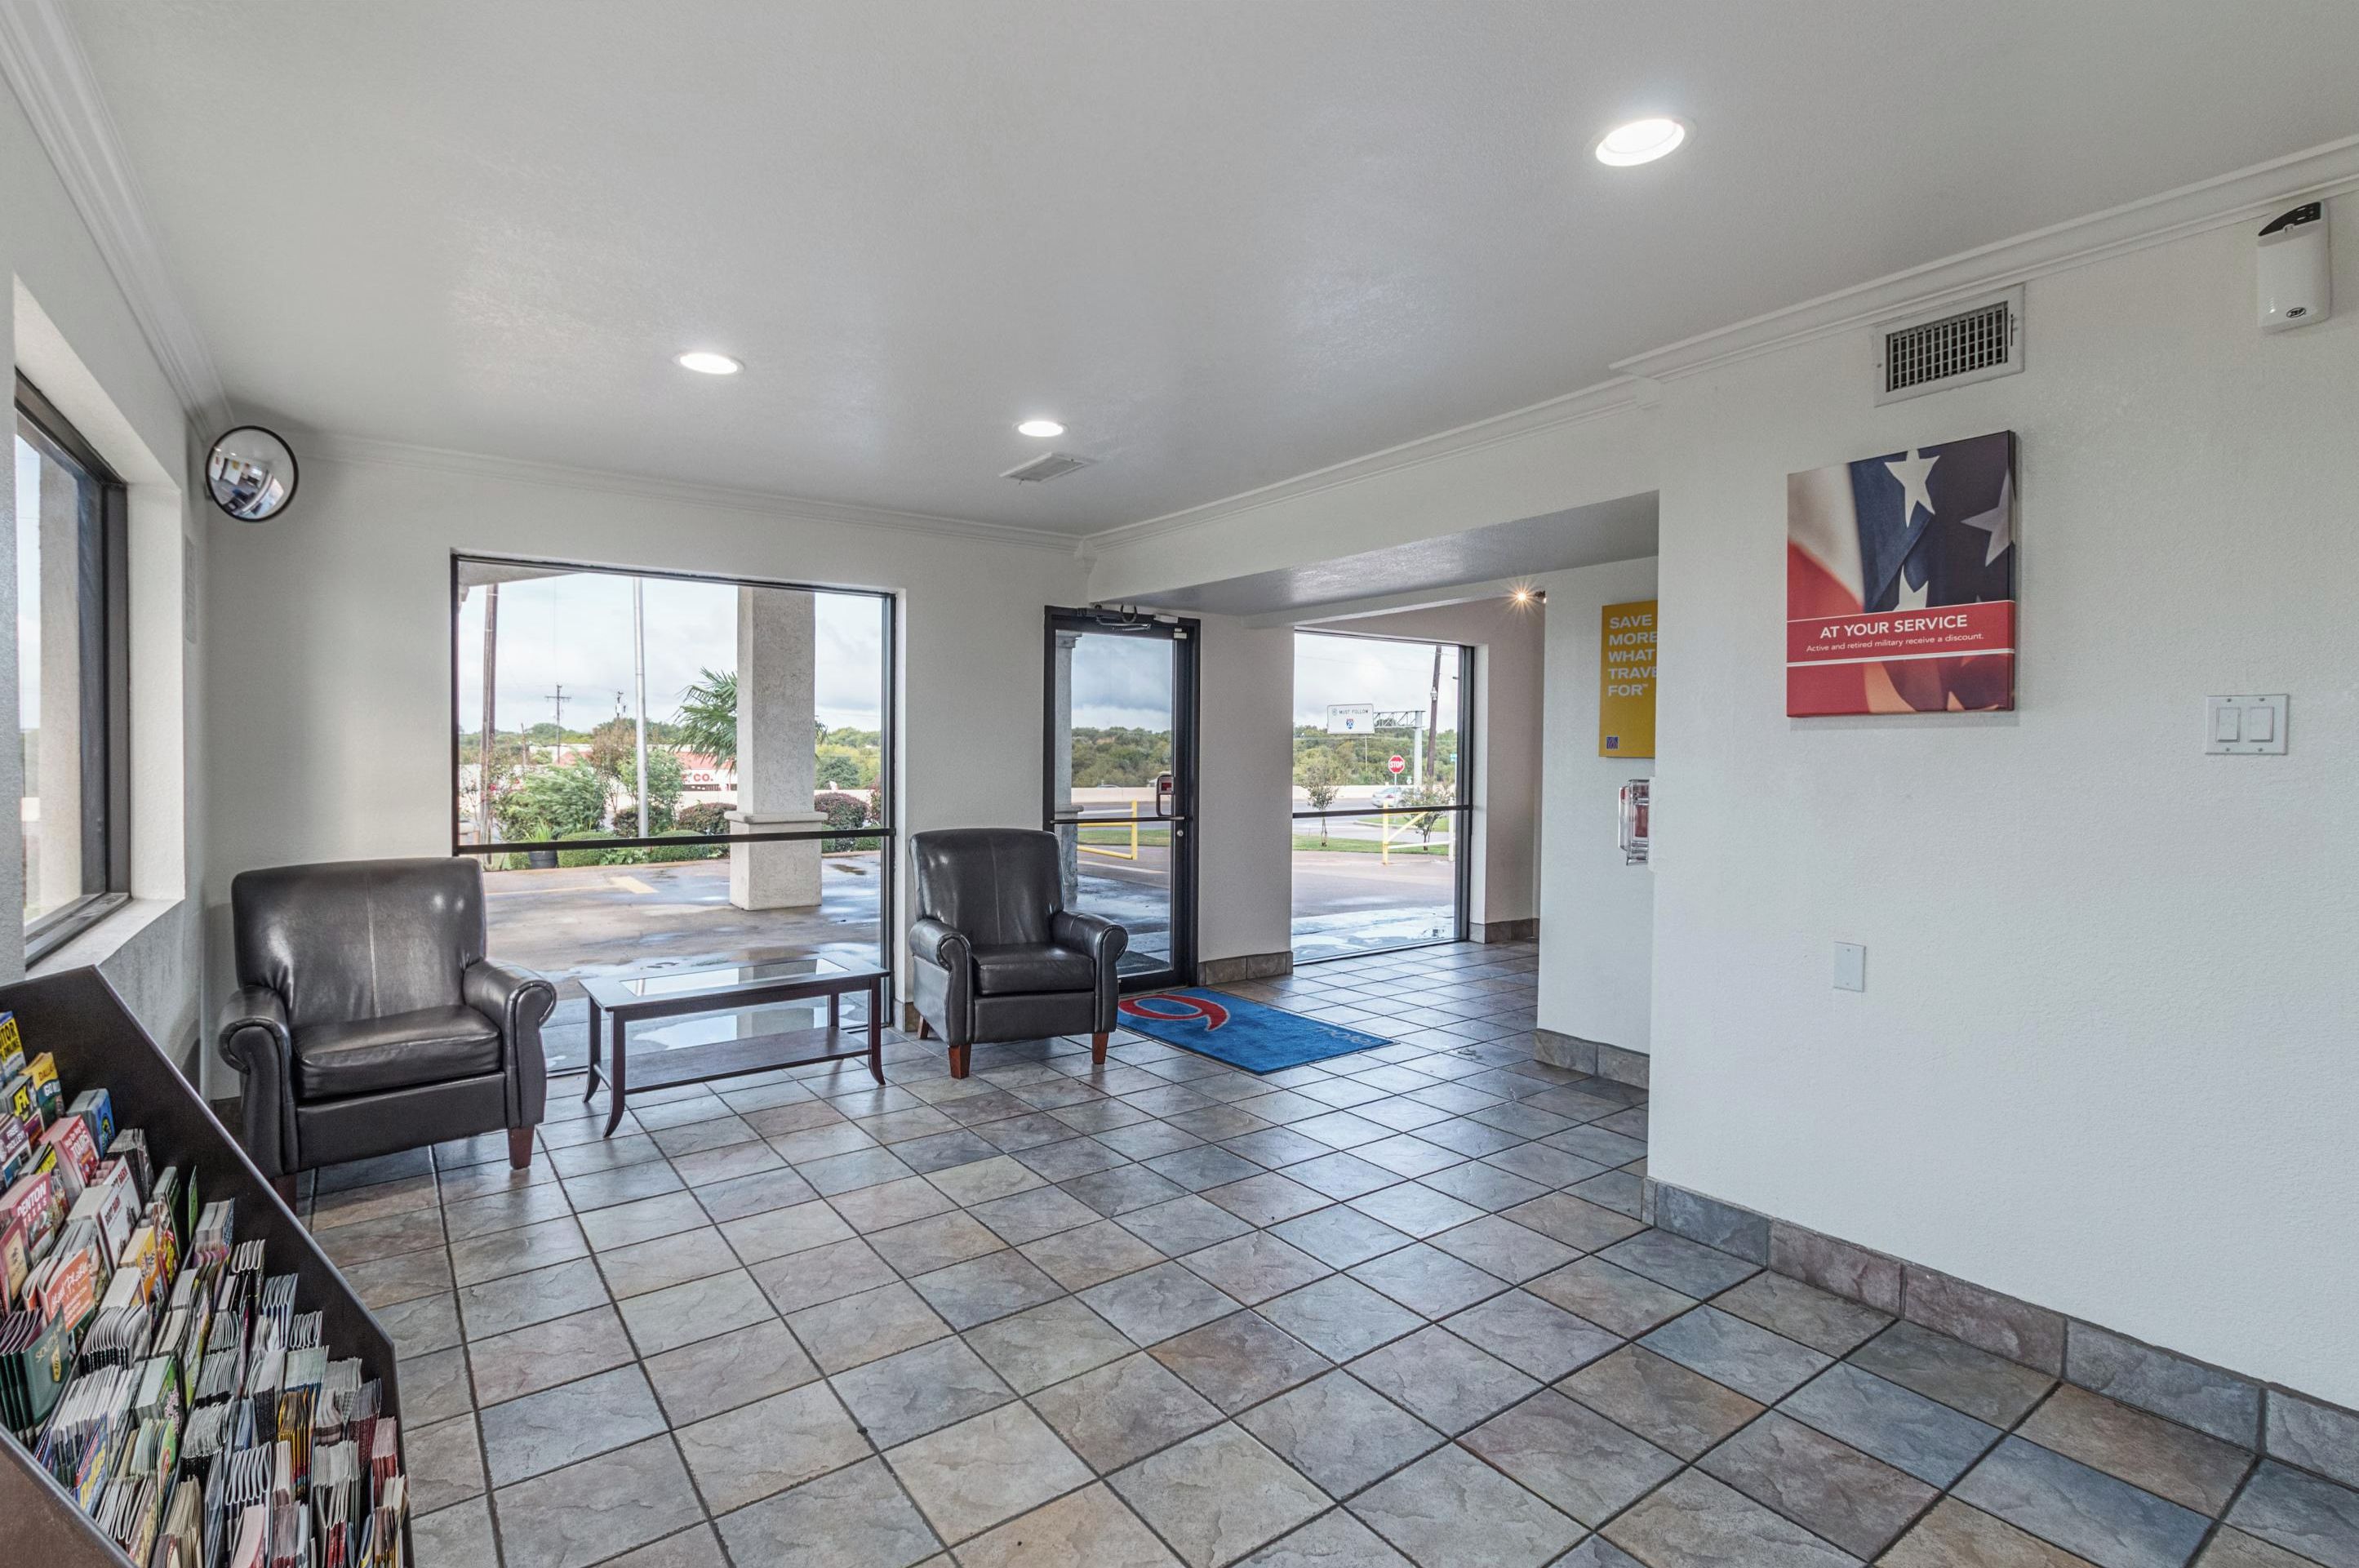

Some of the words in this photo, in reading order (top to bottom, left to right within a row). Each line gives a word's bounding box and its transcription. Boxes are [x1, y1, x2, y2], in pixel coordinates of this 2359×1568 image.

[1609, 614, 1652, 629] SAVE
[1819, 625, 1840, 639] AT
[1844, 621, 1889, 637] YOUR
[1894, 614, 1967, 633] SERVICE
[1609, 631, 1658, 646] MORE
[1806, 643, 1829, 652] Active
[1831, 642, 1846, 651] and
[1847, 640, 1873, 650] retired
[1874, 638, 1904, 648] military
[1905, 637, 1935, 645] receive
[1944, 633, 1984, 642] discount.
[1608, 648, 1655, 663] WHAT
[694, 773, 713, 782] CO.
